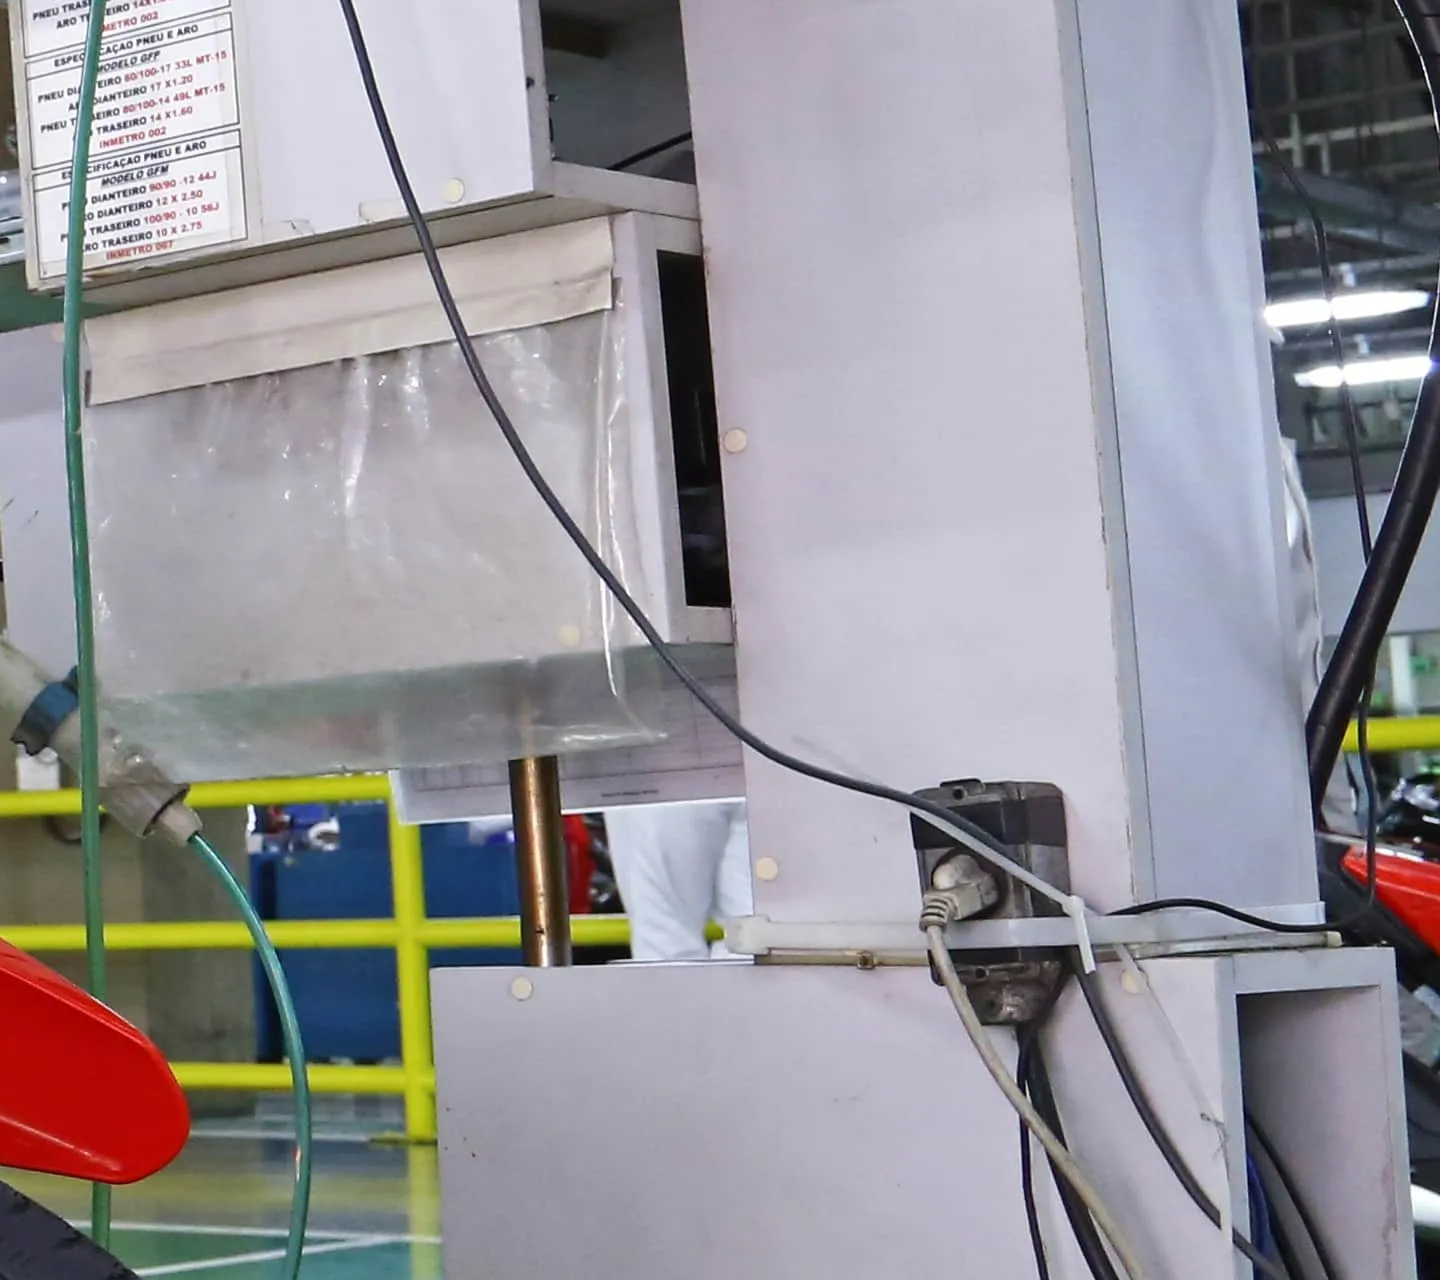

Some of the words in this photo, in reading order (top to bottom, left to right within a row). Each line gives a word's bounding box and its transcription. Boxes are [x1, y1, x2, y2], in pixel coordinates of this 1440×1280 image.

[33, 7, 59, 20] PNEU
[56, 17, 77, 29] ARO
[136, 32, 164, 47] PNEU
[166, 30, 174, 39] E
[176, 24, 199, 38] ARO
[38, 90, 64, 103] PNEU
[175, 59, 193, 70] 33L
[196, 50, 227, 65] MT-15
[150, 82, 162, 93] 17
[40, 120, 67, 133] PNEU
[194, 82, 226, 97] MT-15
[96, 115, 147, 135] TRASEIRO
[99, 131, 146, 149] INMETRO
[148, 126, 167, 139] 002
[143, 148, 172, 162] PNEU
[175, 146, 182, 155] E
[184, 140, 207, 153] ARO
[101, 170, 145, 188] MODELO
[146, 164, 170, 179] GFM
[91, 185, 147, 205] DIANTEIRO
[97, 199, 153, 219] DIANTEIRO
[156, 196, 168, 207] 12
[171, 194, 179, 204] X
[181, 189, 204, 202] 2.50
[89, 218, 141, 236] TRASEIRO
[186, 207, 198, 216] 10
[82, 242, 99, 253] RO
[101, 231, 153, 249] TRASEIRO
[156, 228, 168, 237] 10
[171, 227, 179, 235] X
[181, 221, 203, 234] 2.75
[106, 244, 152, 261] INMETRO
